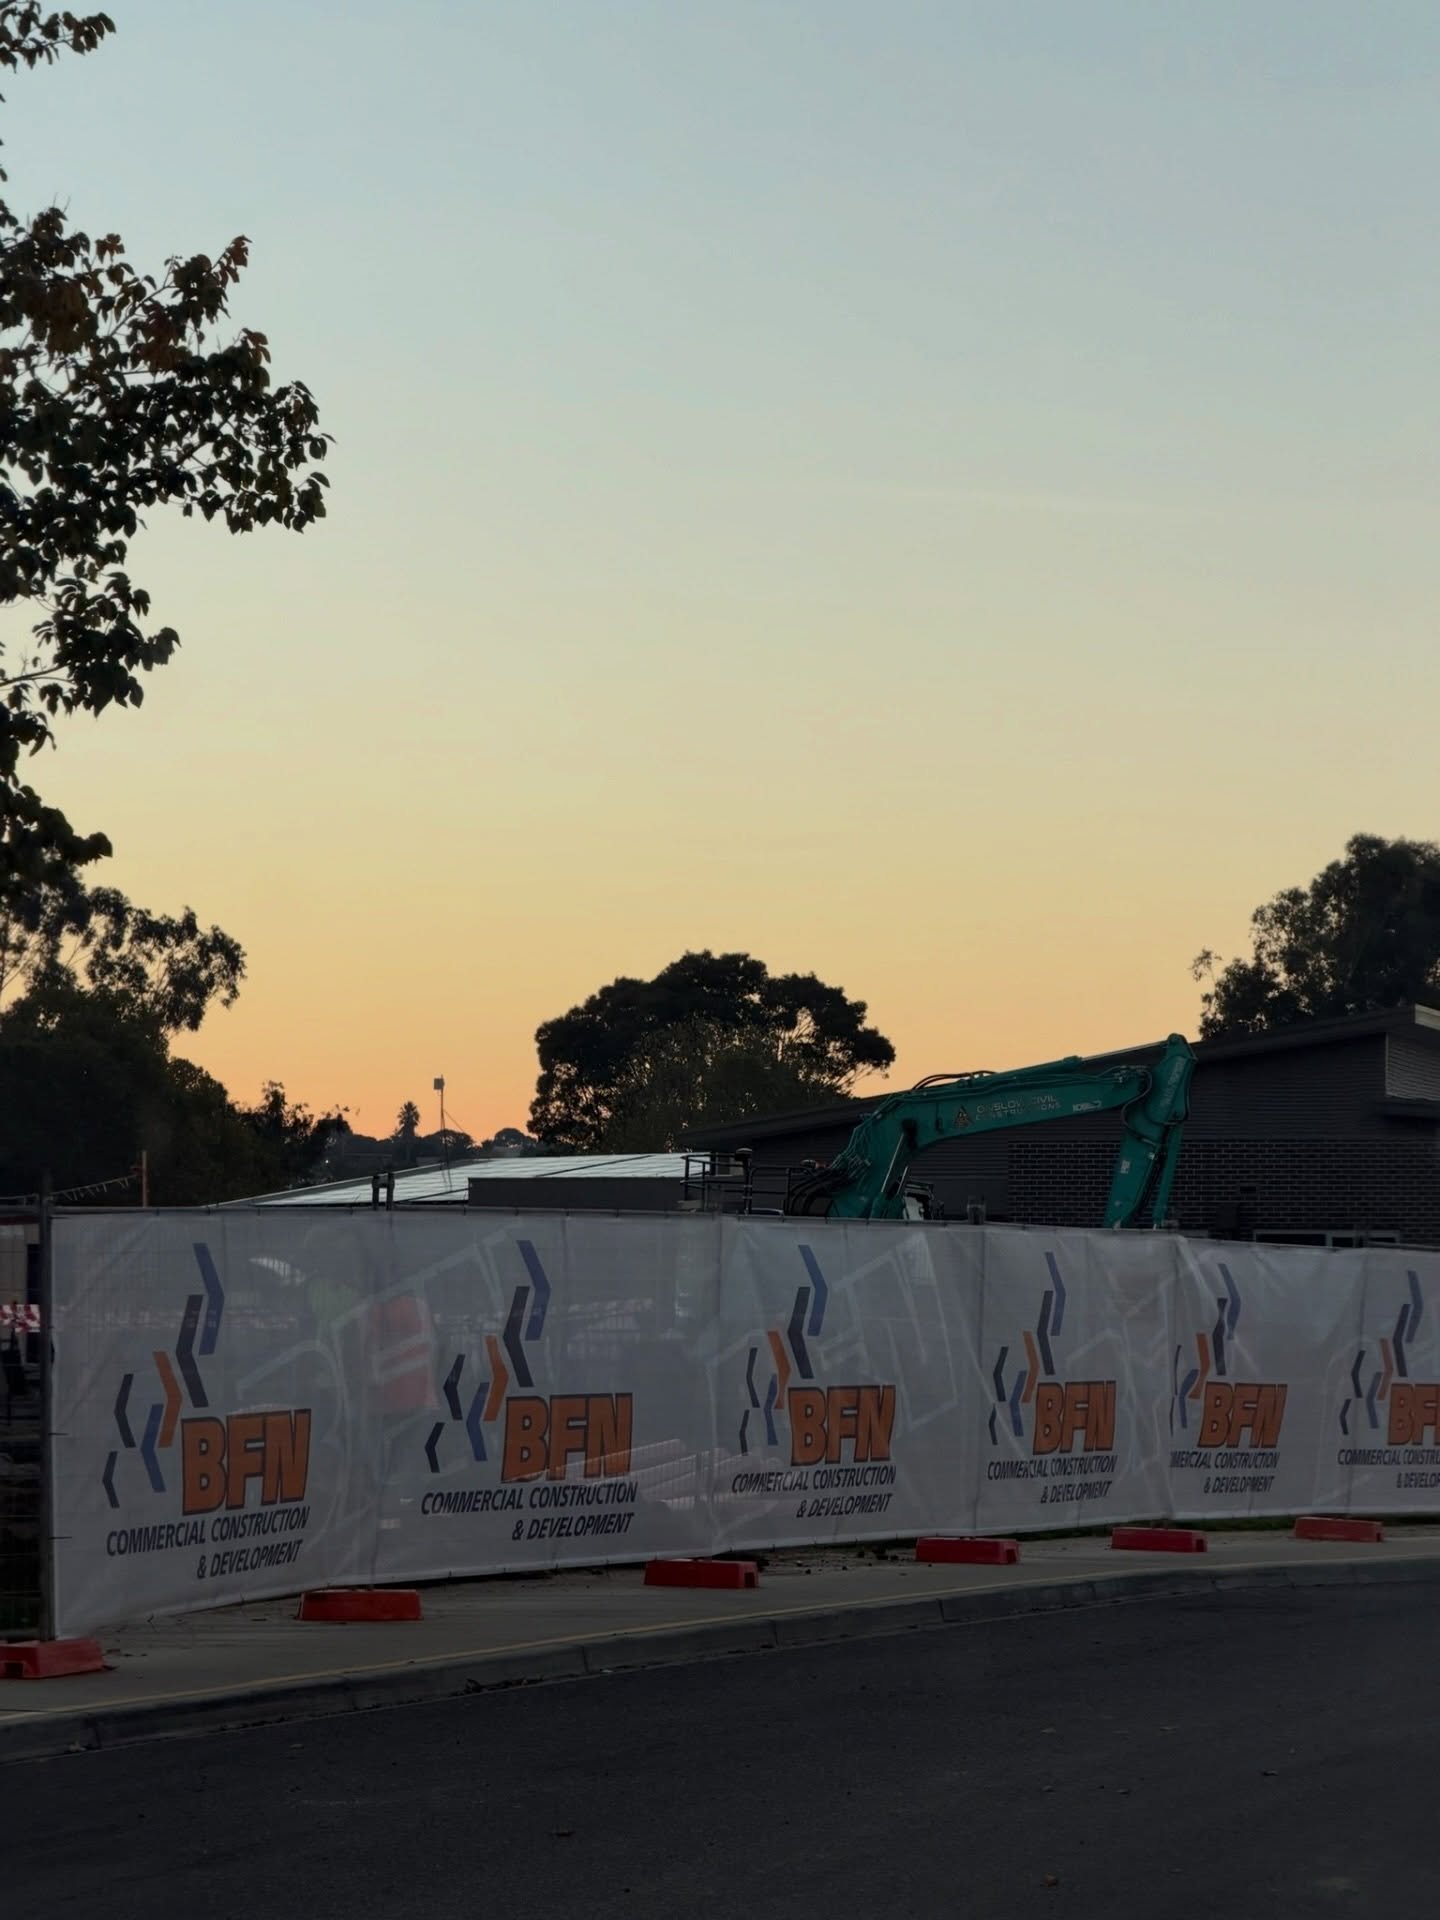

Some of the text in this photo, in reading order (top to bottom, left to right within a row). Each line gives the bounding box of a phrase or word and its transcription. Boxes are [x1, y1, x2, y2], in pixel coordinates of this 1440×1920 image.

[788, 1385, 896, 1466] BFN
[1032, 1381, 1116, 1455] BFN
[1197, 1381, 1288, 1448] BFN
[1388, 1383, 1440, 1446] BF
[501, 1393, 633, 1483] BFN
[181, 1409, 311, 1515] BFN
[987, 1455, 1118, 1480] COMMERCIAL CONSTRUCTION
[1214, 1451, 1280, 1469] CONSTRUCTION
[1338, 1448, 1401, 1465] COMMERCIAL
[732, 1465, 896, 1493] COMMERCIAL CONSTRUCTION
[1040, 1480, 1112, 1504] & DEVELOPMENT
[1203, 1475, 1275, 1494] & DEVELOPMENT
[421, 1482, 638, 1515] COMMERCIAL CONSTRUCTION
[796, 1493, 893, 1518] & DEVELOPMENT
[106, 1506, 311, 1556] COMMERCIAL CONSTRUCTION
[512, 1512, 635, 1541] & DEVELOPMENT
[196, 1539, 303, 1580] & DEVELOPMENT
